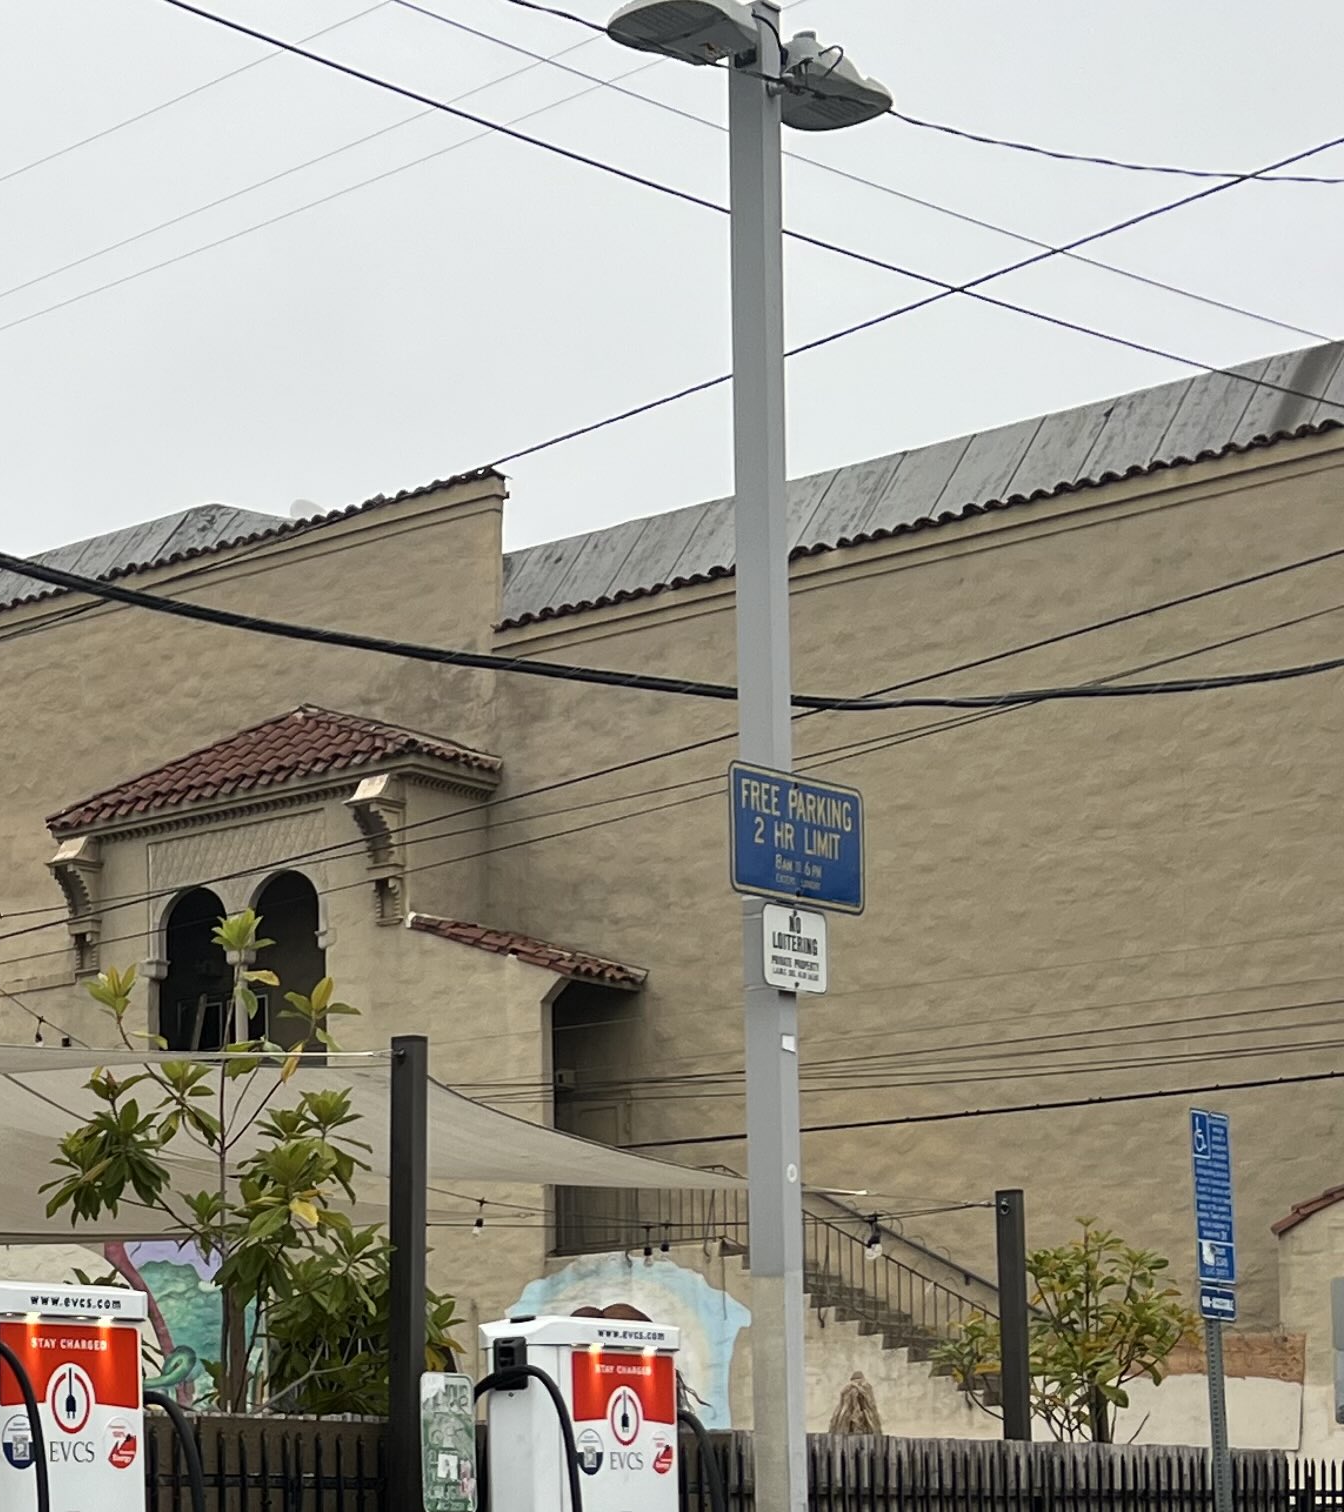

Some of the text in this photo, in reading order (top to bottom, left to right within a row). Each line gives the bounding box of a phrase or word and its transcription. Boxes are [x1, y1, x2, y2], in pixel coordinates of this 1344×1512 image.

[741, 778, 852, 832] FREE PARKING
[754, 816, 841, 860] 2 HR LIMIT
[789, 915, 802, 934] NO
[772, 931, 818, 956] LOITERING
[30, 1295, 122, 1310] www.evcs.com
[31, 1337, 108, 1352] STAY CHARGED
[50, 1441, 95, 1463] EVCS
[610, 1451, 644, 1471] EVCS
